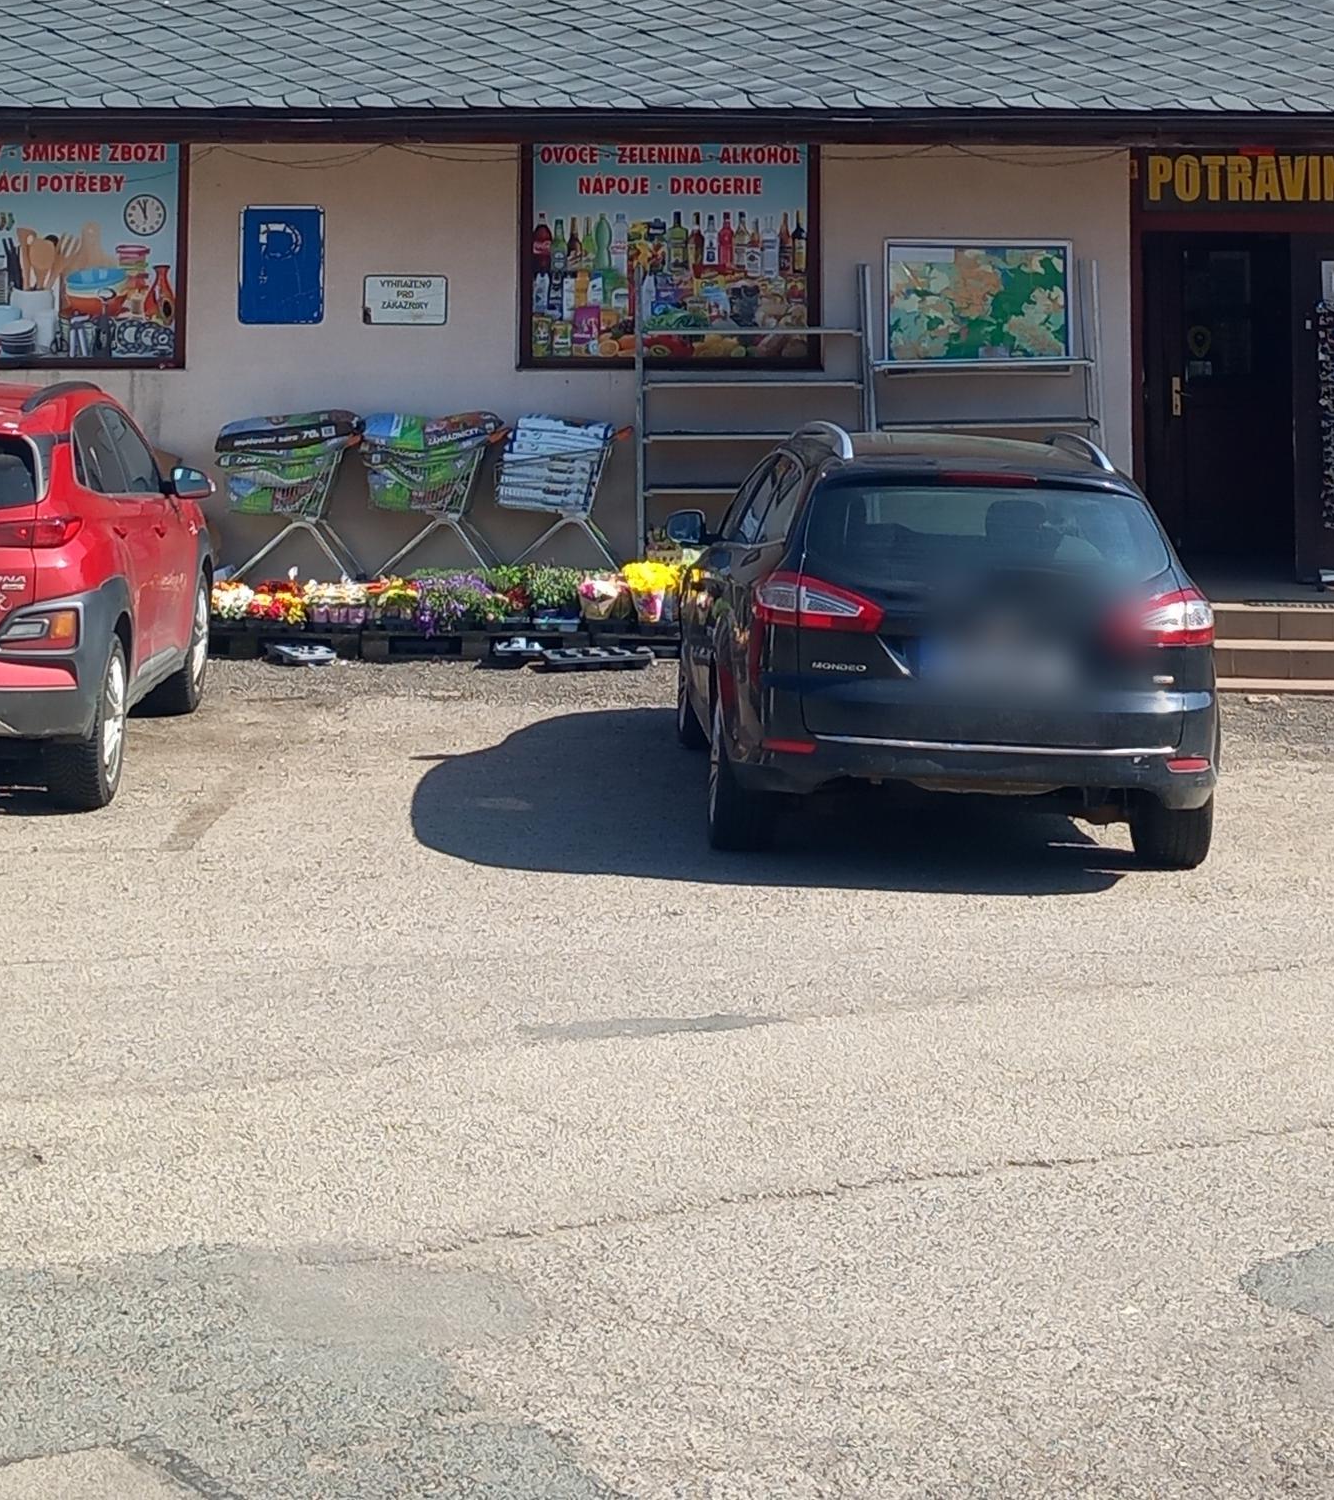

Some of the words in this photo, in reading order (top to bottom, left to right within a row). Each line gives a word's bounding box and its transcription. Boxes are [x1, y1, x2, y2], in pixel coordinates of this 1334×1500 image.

[540, 146, 598, 164] OVOCE
[616, 146, 703, 164] ZELENINA
[719, 146, 801, 164] ALKOHOL
[36, 170, 125, 193] POTŘEBY
[578, 173, 650, 195] NÁPOJE
[669, 176, 762, 196] DROGERIE
[396, 290, 415, 299] PRO
[811, 661, 868, 673] MONDEO
